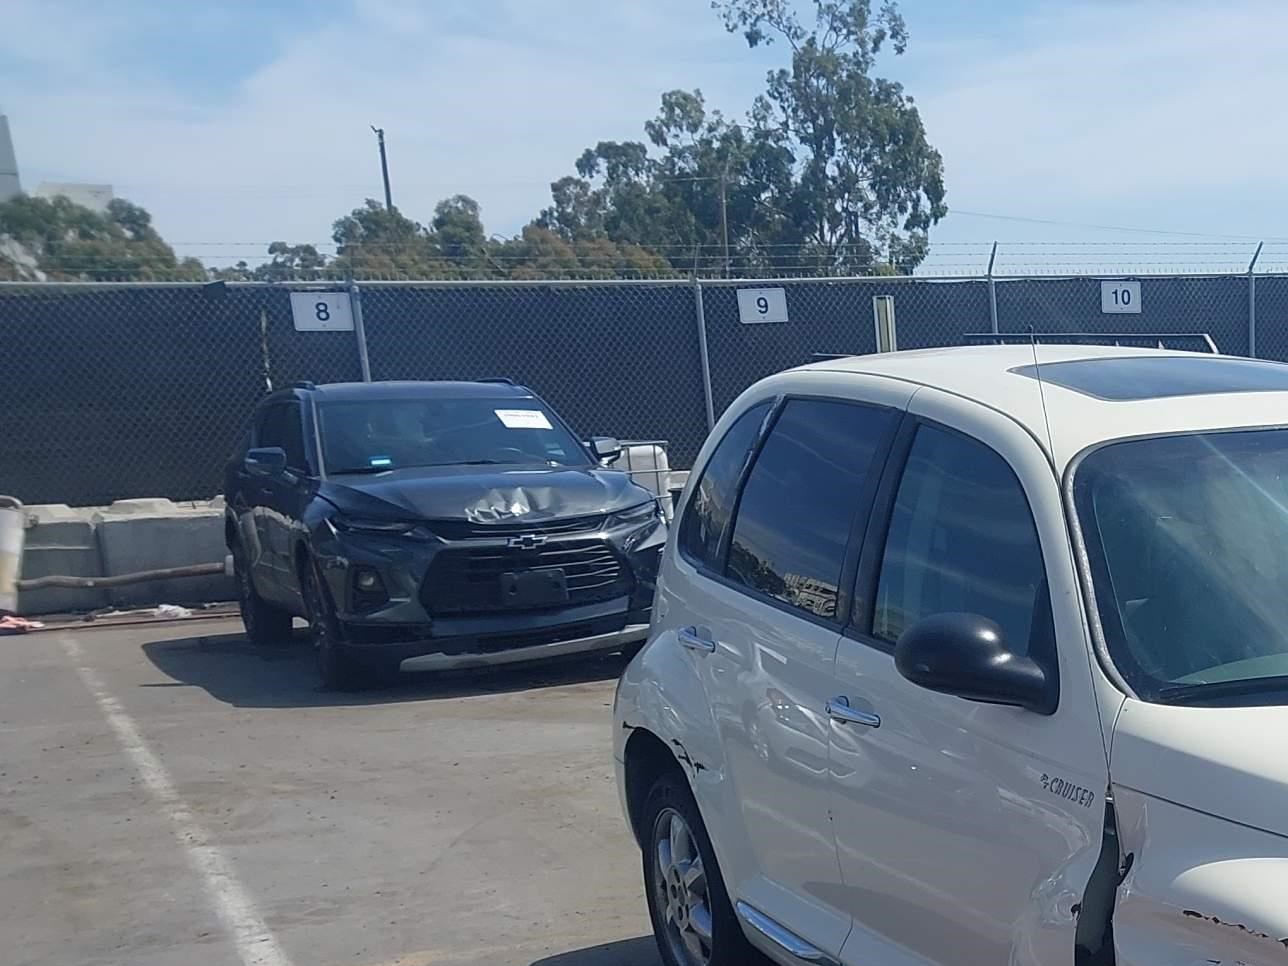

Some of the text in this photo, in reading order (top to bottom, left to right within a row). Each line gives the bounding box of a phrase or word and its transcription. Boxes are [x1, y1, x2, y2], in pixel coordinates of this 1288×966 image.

[756, 296, 769, 314] 9
[1111, 288, 1132, 306] 10
[315, 302, 330, 322] 8
[1050, 777, 1095, 809] CRUISER
